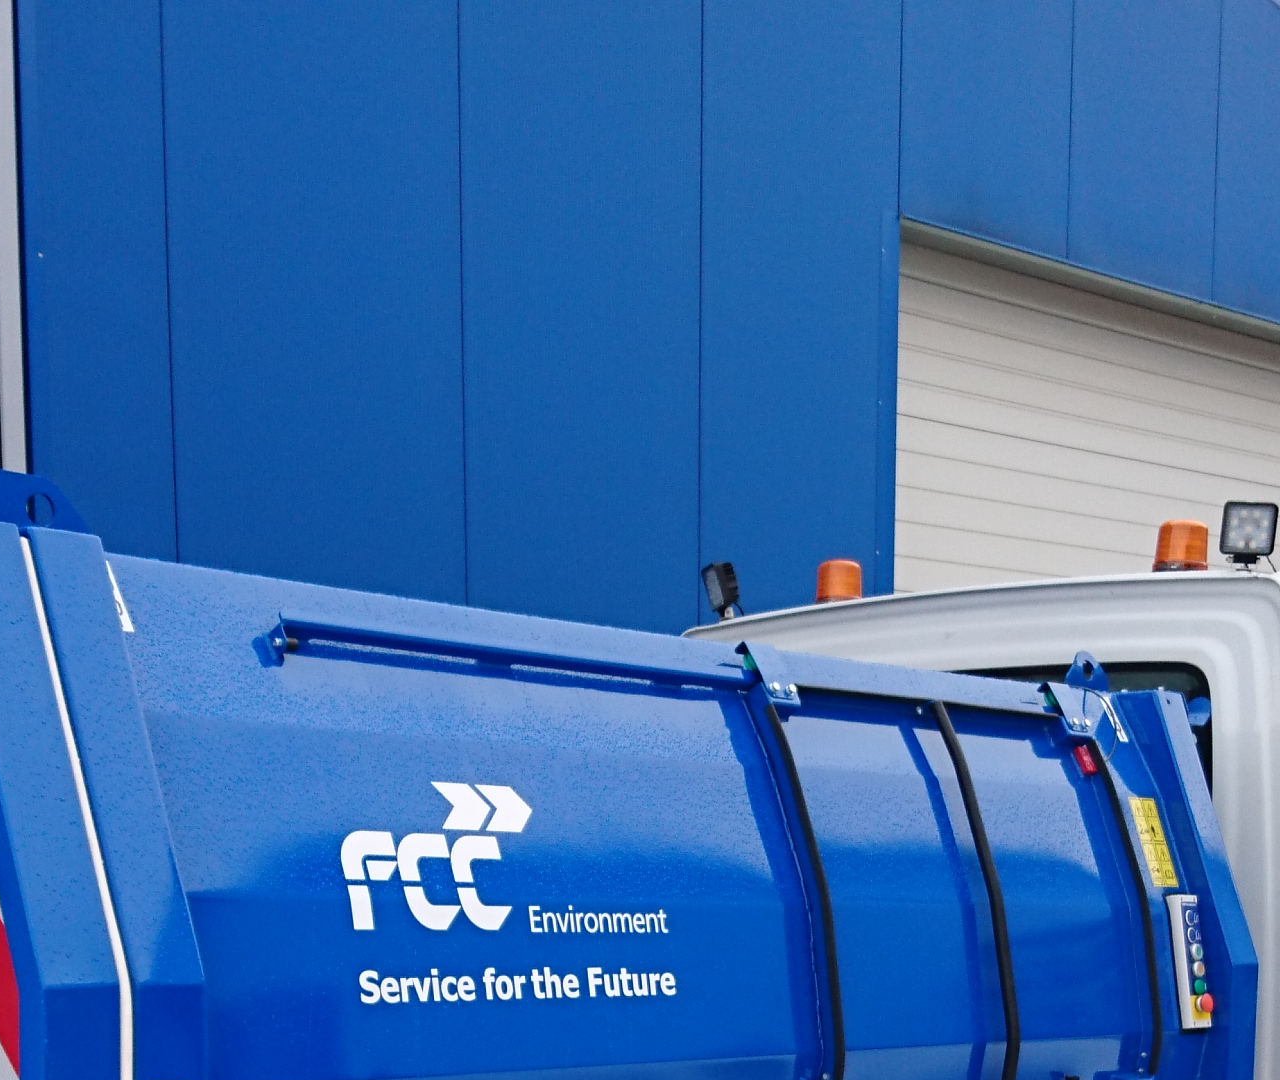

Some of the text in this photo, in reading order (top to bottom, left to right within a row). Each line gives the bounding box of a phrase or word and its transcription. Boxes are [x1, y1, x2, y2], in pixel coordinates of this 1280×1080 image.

[340, 830, 669, 934] FCC Environment
[358, 966, 677, 1004] Service for the Future
